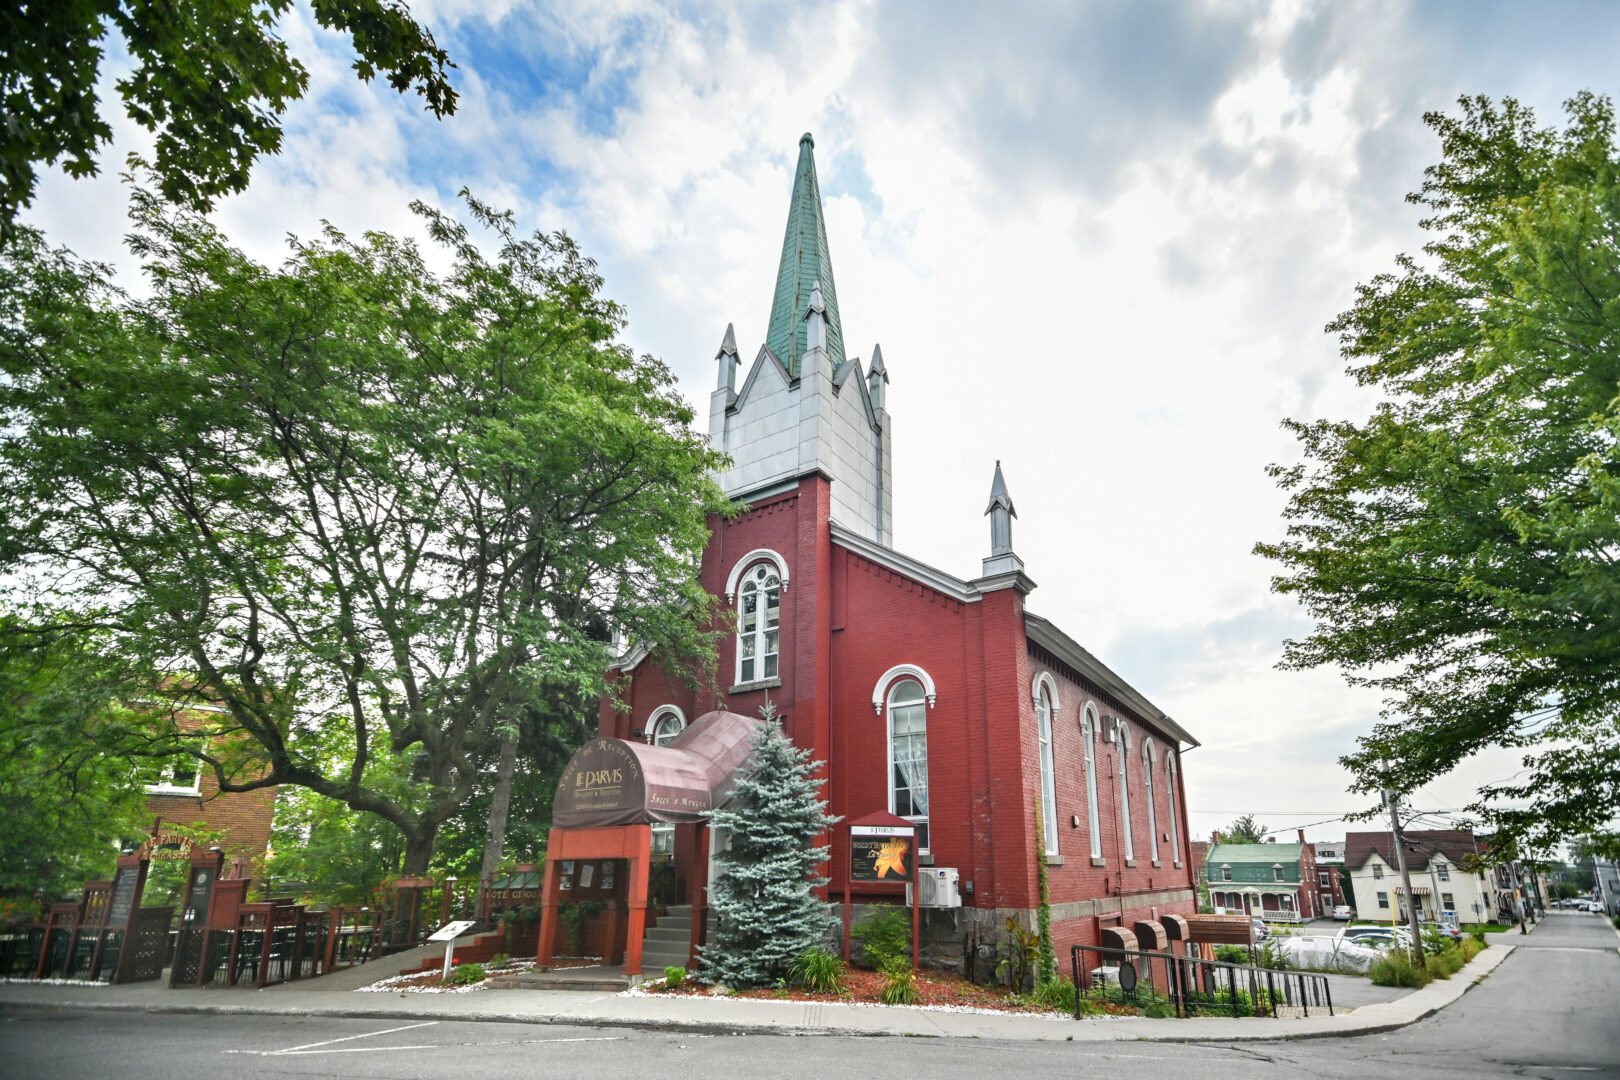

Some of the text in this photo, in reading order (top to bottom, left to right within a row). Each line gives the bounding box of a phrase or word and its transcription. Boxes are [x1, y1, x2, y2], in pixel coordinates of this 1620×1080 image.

[576, 768, 623, 788] LE PARVIS
[160, 834, 194, 849] PARVIS
